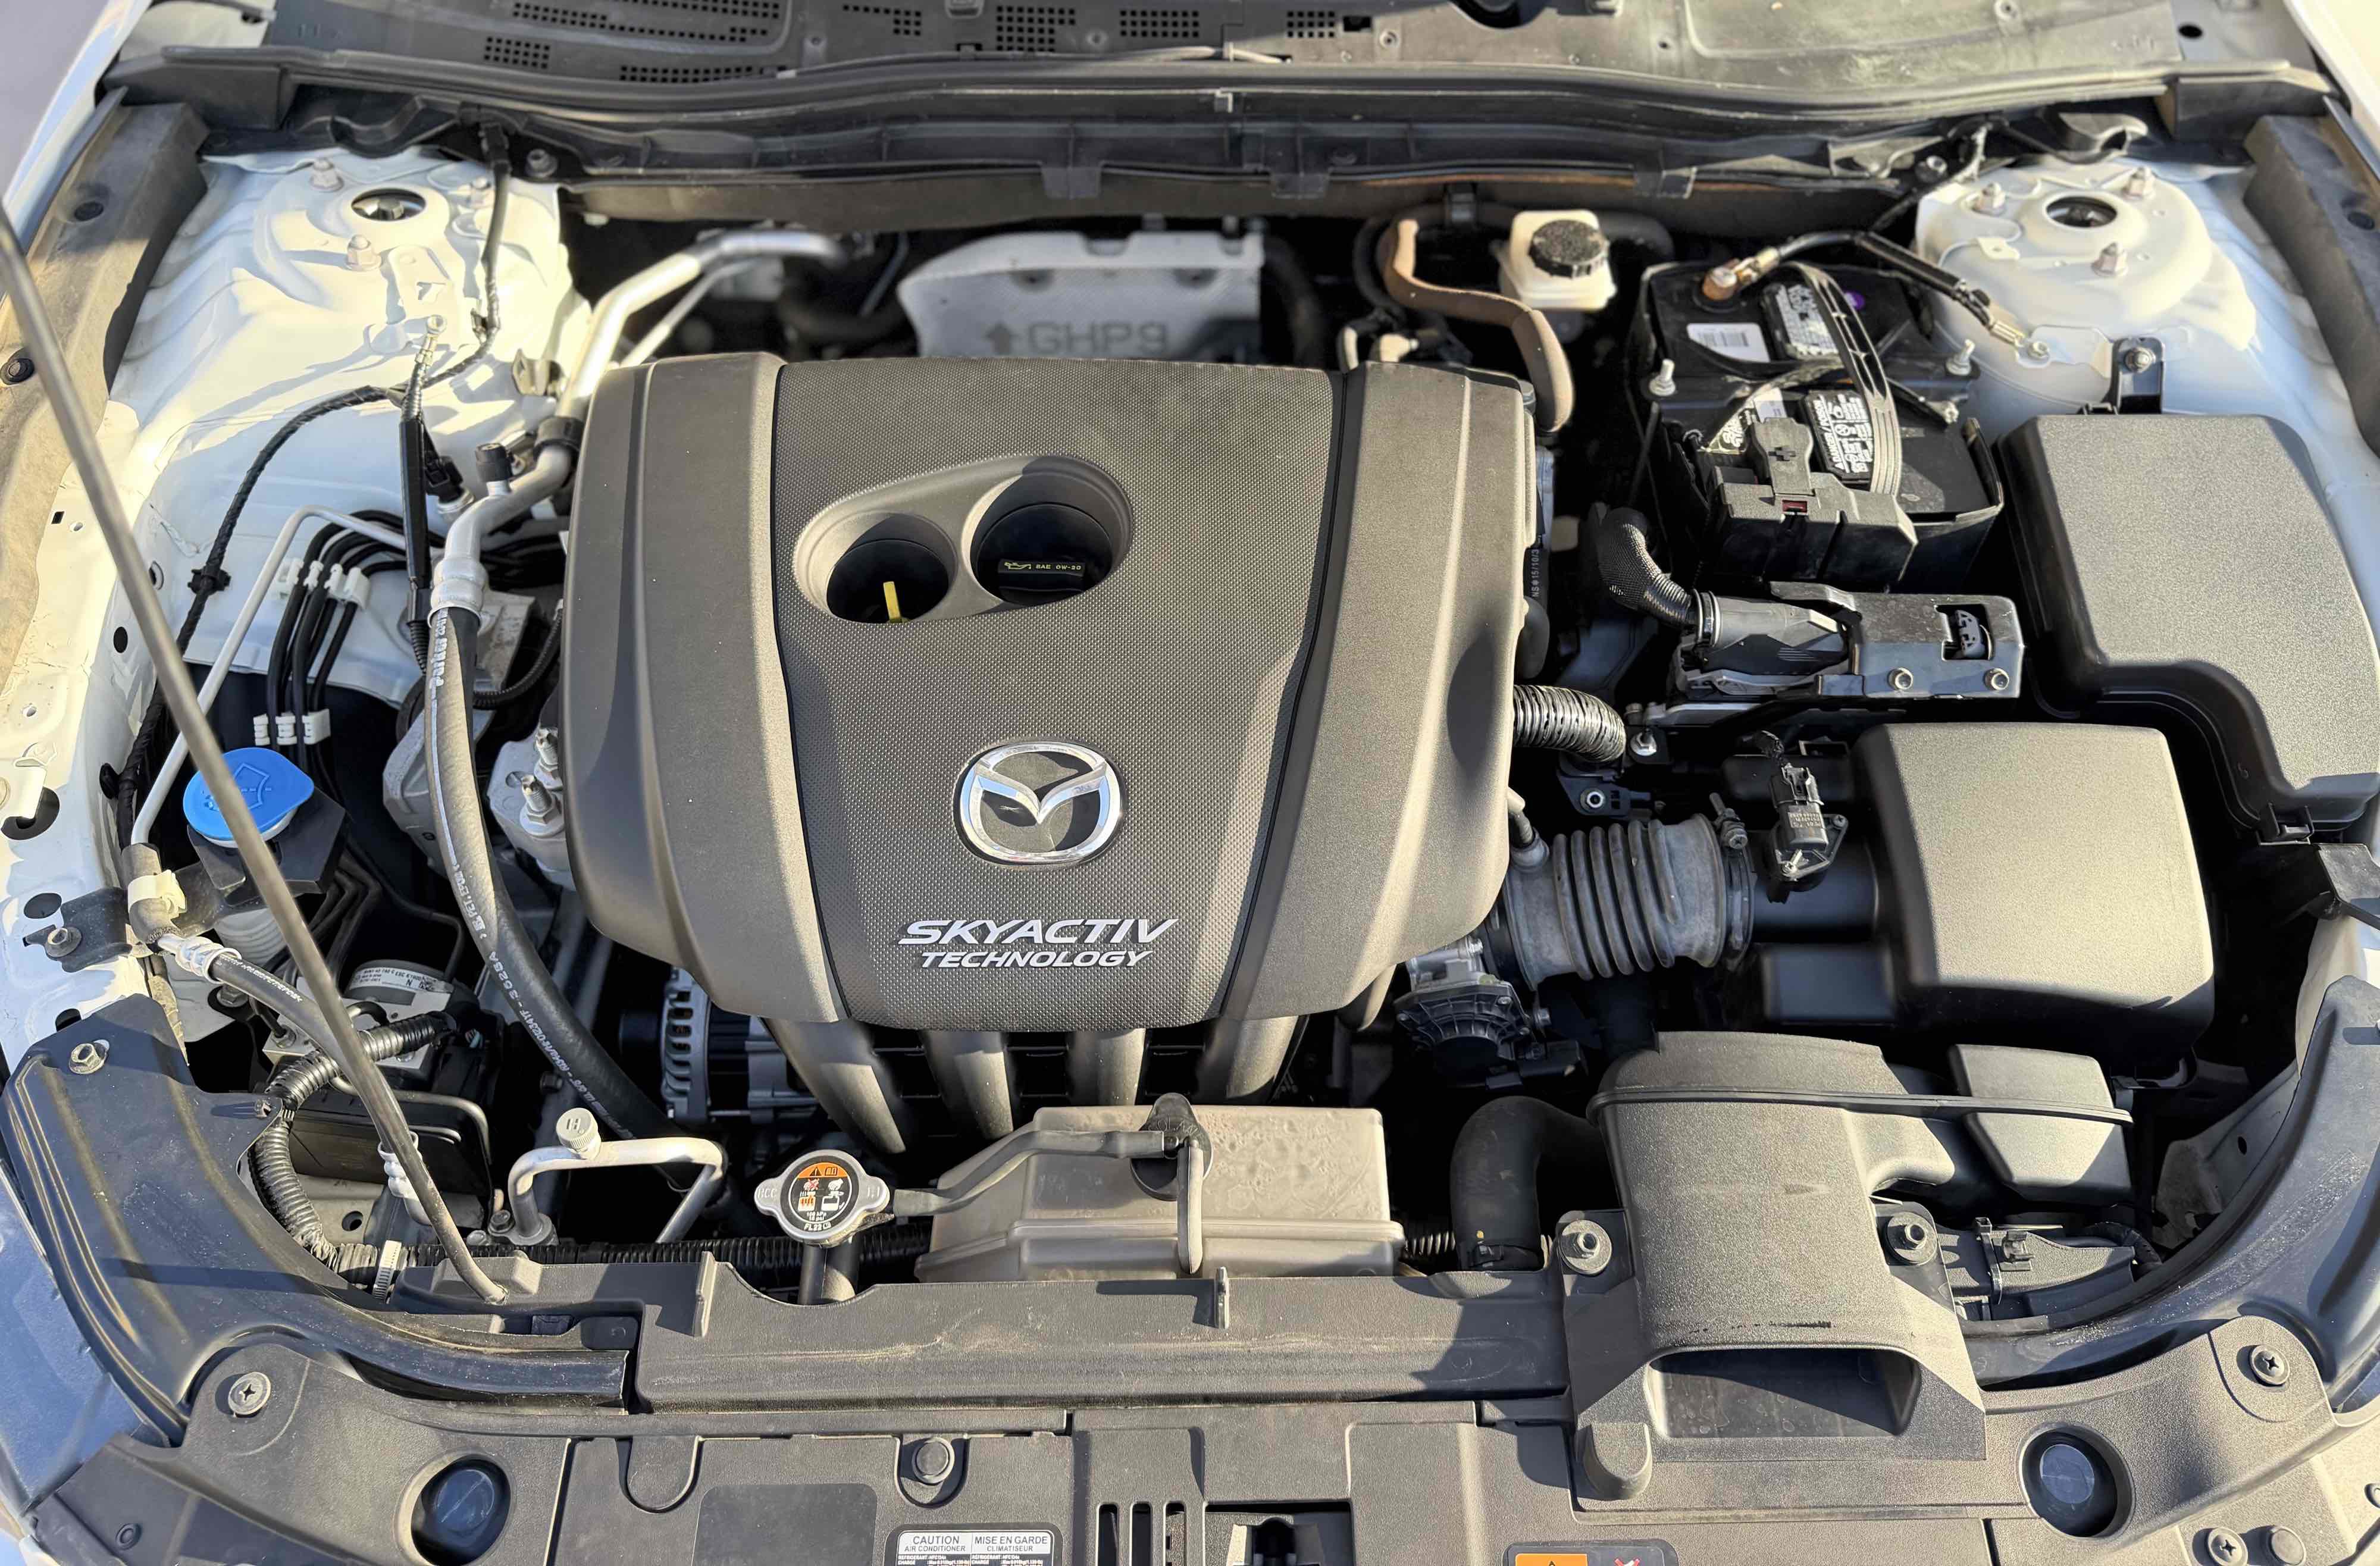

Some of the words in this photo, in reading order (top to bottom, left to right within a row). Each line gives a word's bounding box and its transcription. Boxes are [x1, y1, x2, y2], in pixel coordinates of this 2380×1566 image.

[1028, 322, 1166, 355] GHP9
[898, 919, 1179, 944] SKYACTIV
[922, 951, 1153, 968] TECHNOLOGY
[913, 1536, 960, 1545] CAUTION
